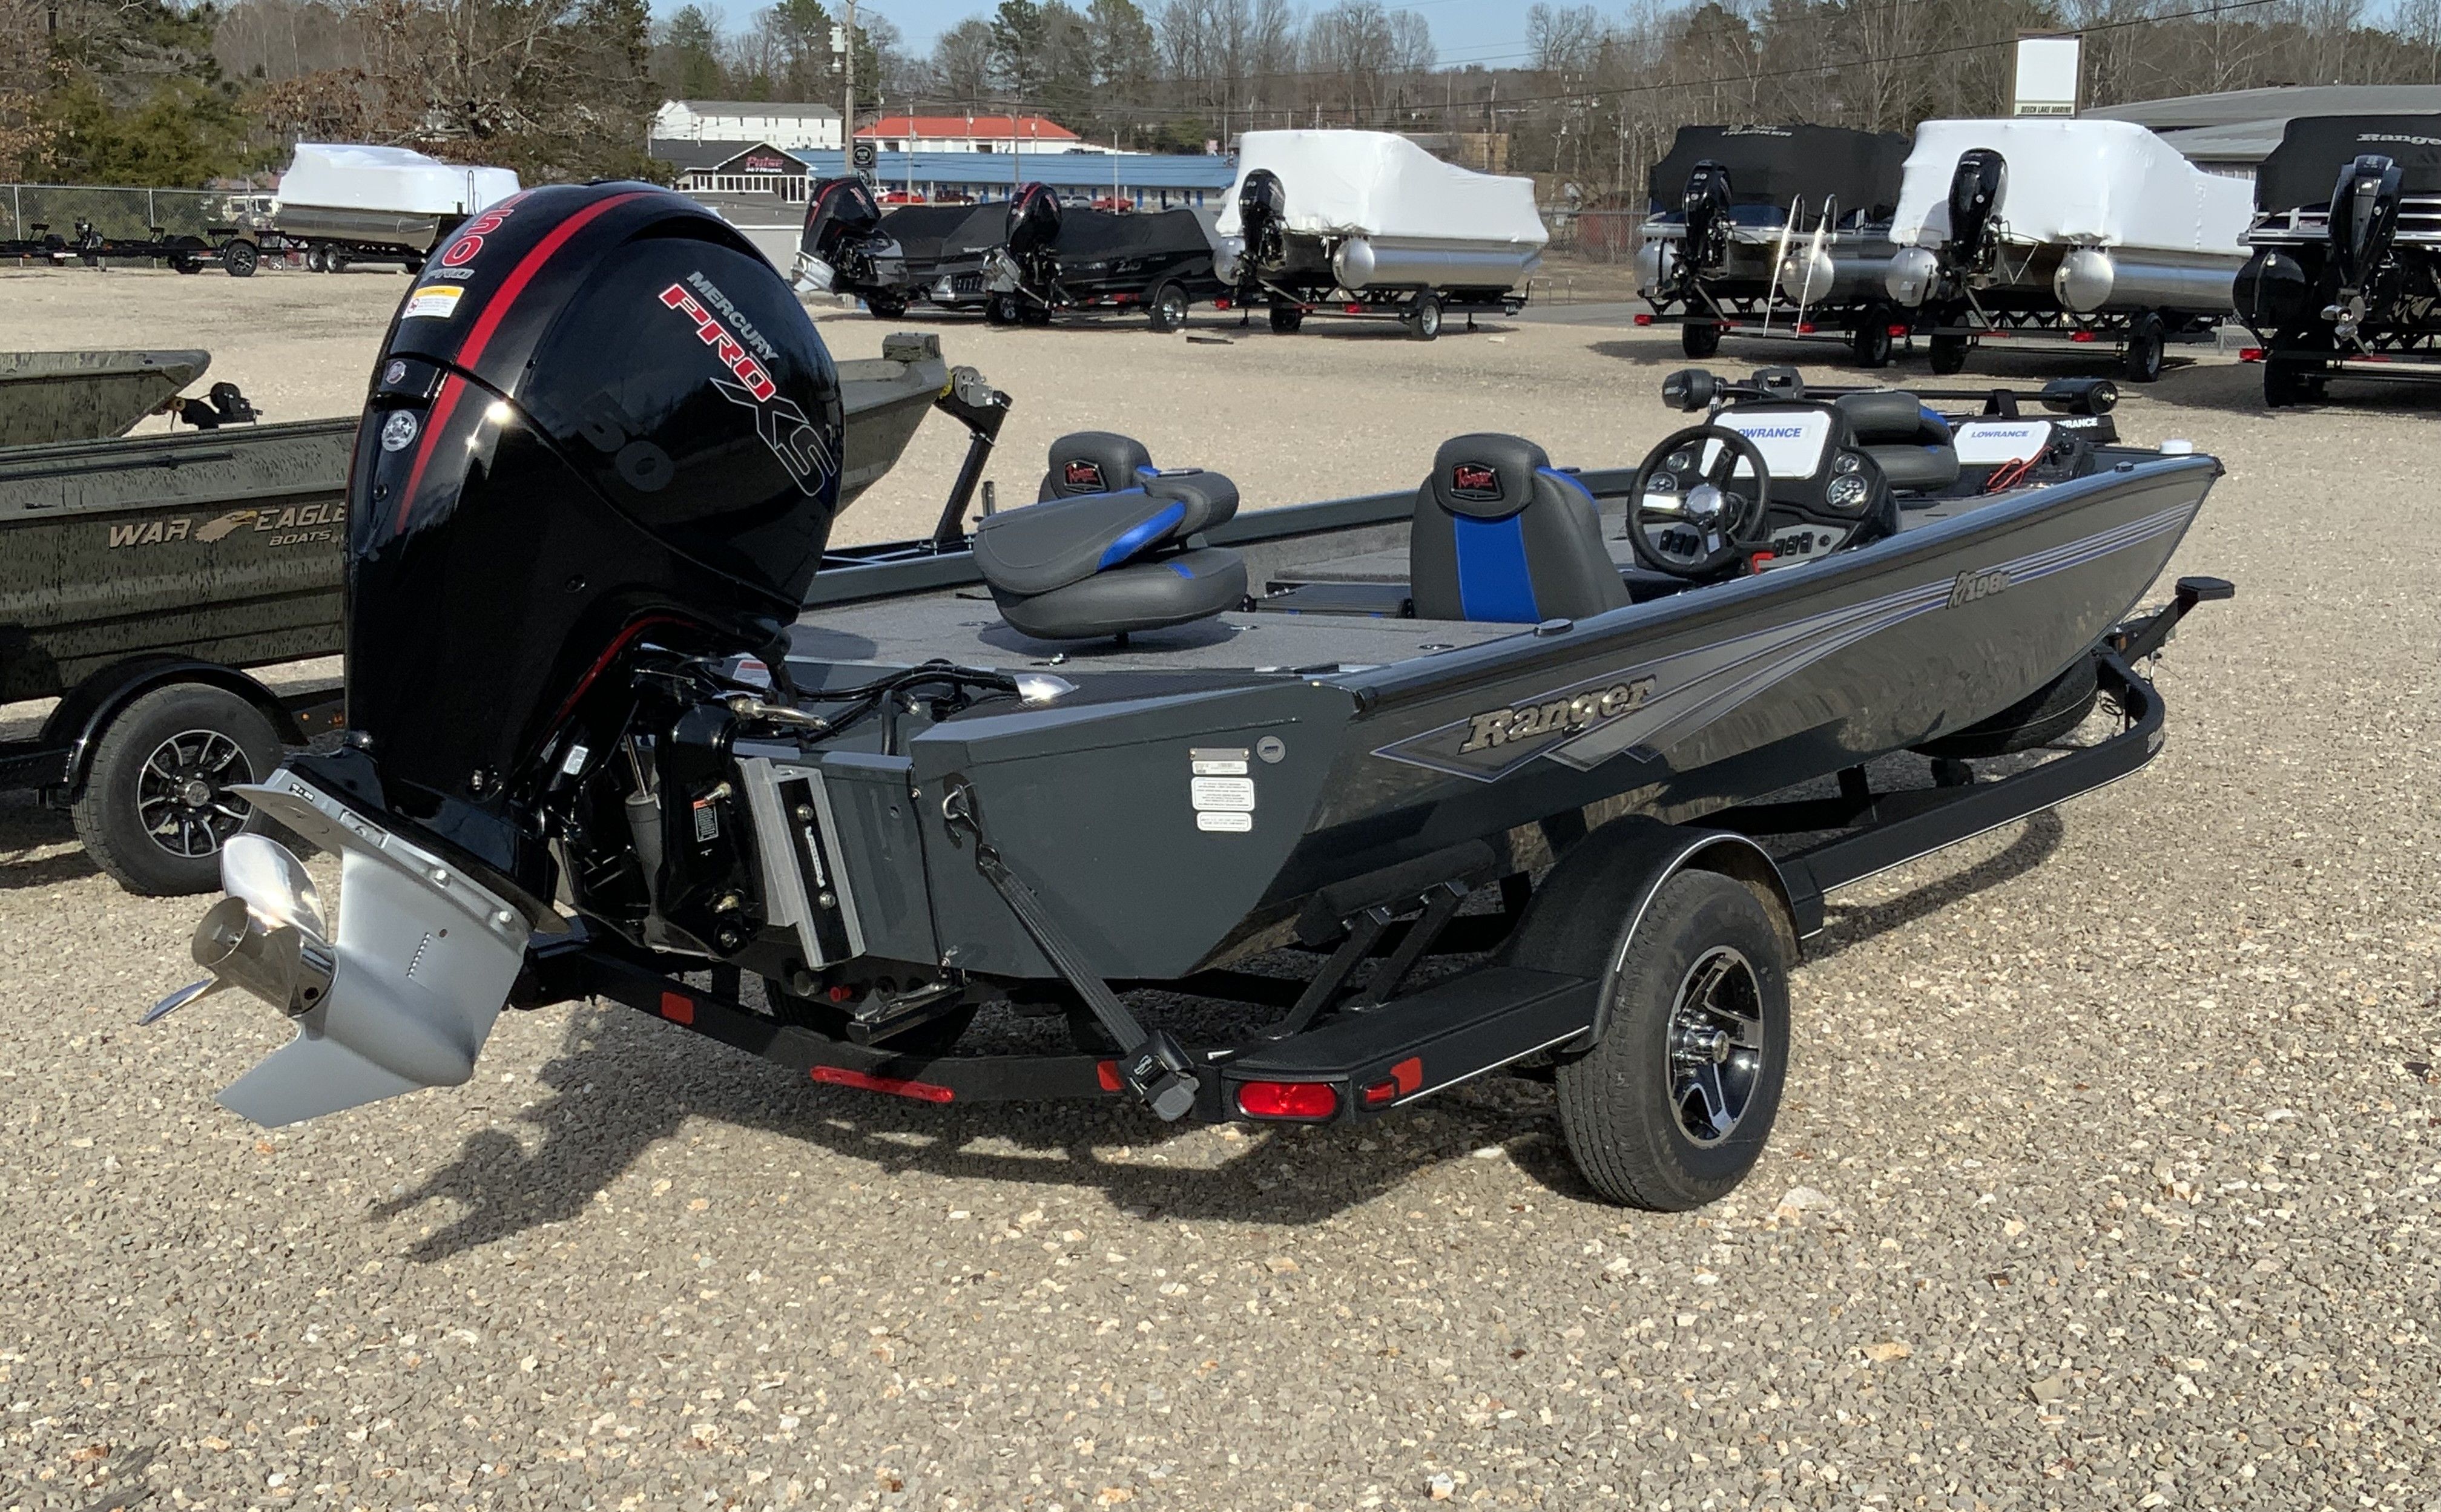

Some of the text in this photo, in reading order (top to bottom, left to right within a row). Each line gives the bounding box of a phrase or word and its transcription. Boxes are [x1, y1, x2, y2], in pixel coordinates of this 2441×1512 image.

[2356, 134, 2441, 145] Range
[687, 271, 779, 362] MERCURY
[659, 283, 776, 402] PRO
[1738, 427, 1802, 438] OWRANCE
[108, 518, 192, 548] WAR
[269, 530, 332, 547] BOATS
[1458, 675, 1656, 754] Ranger
